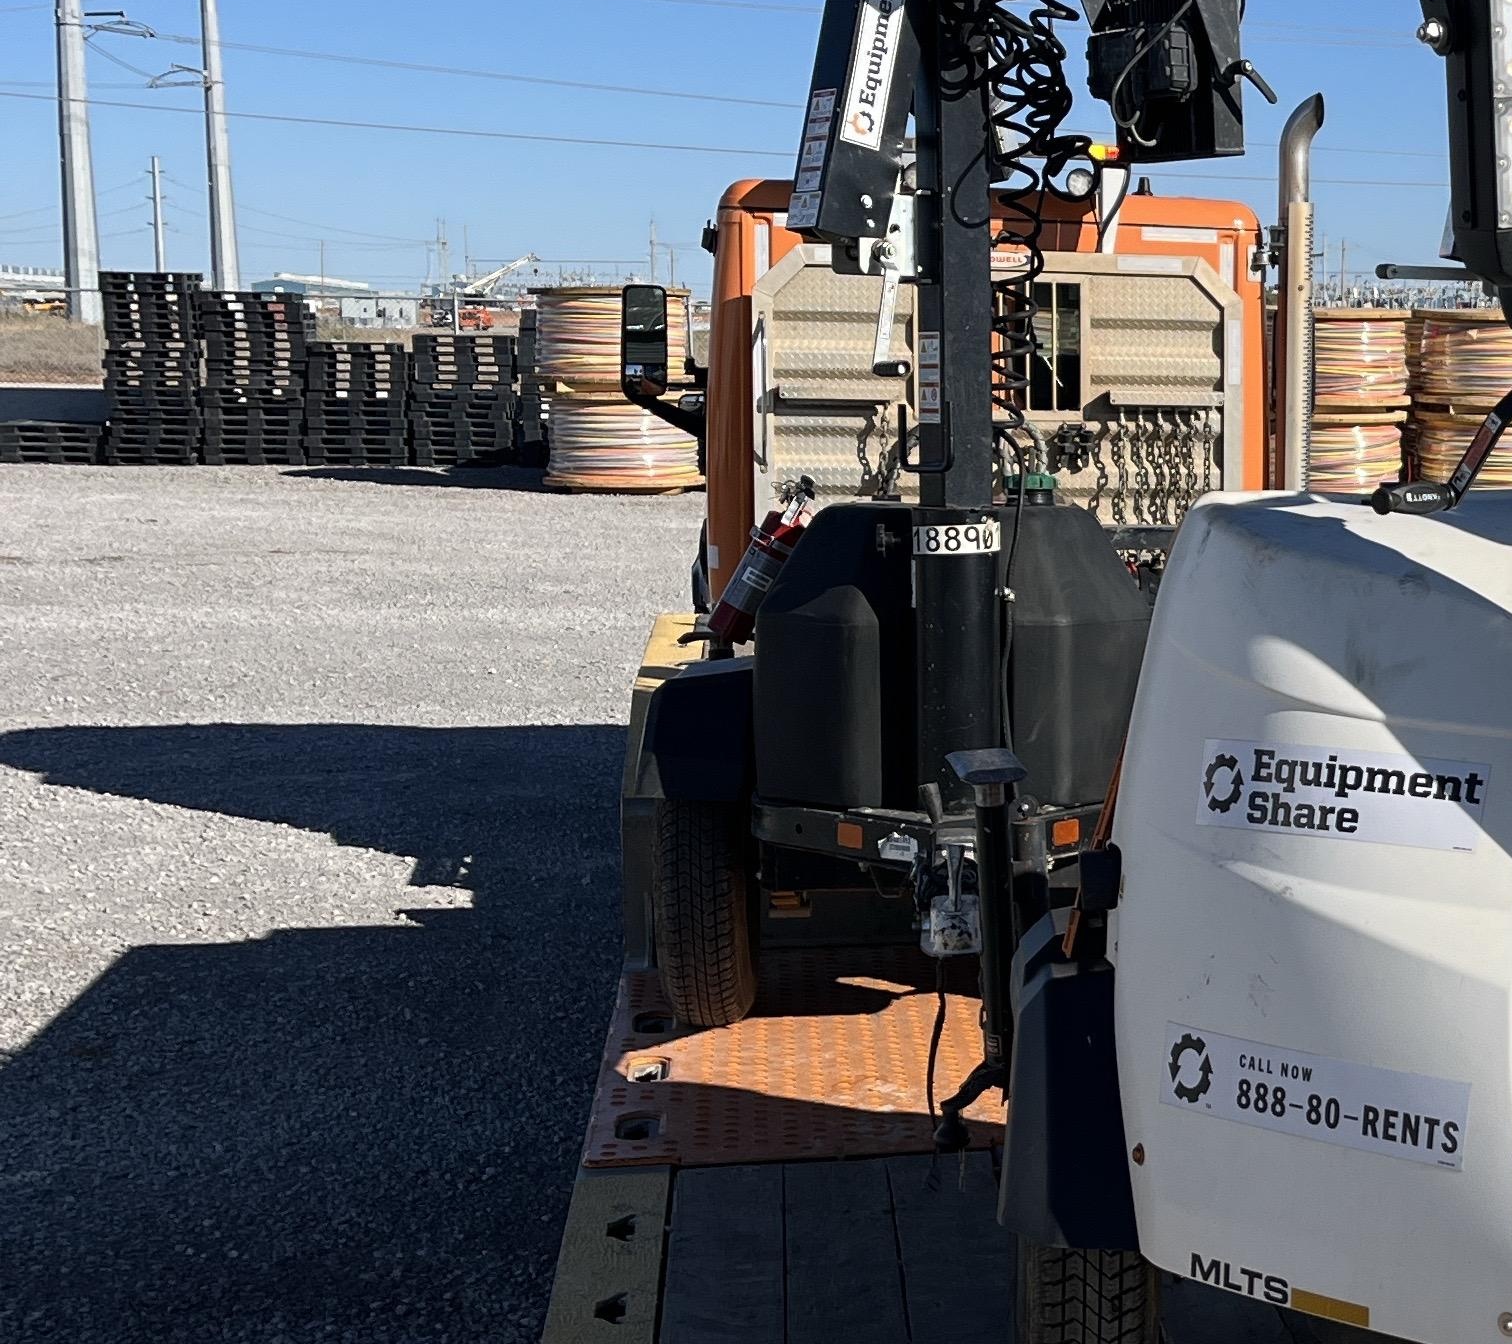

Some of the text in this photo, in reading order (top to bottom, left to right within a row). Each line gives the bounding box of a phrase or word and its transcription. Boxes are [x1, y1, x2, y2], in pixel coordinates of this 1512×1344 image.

[1250, 748, 1484, 805] Equipment
[1246, 790, 1360, 834] Share
[1239, 1053, 1313, 1083] CALL NOW
[1236, 1078, 1460, 1154] 888-80-RENTS
[1191, 1252, 1289, 1305] MLTS
